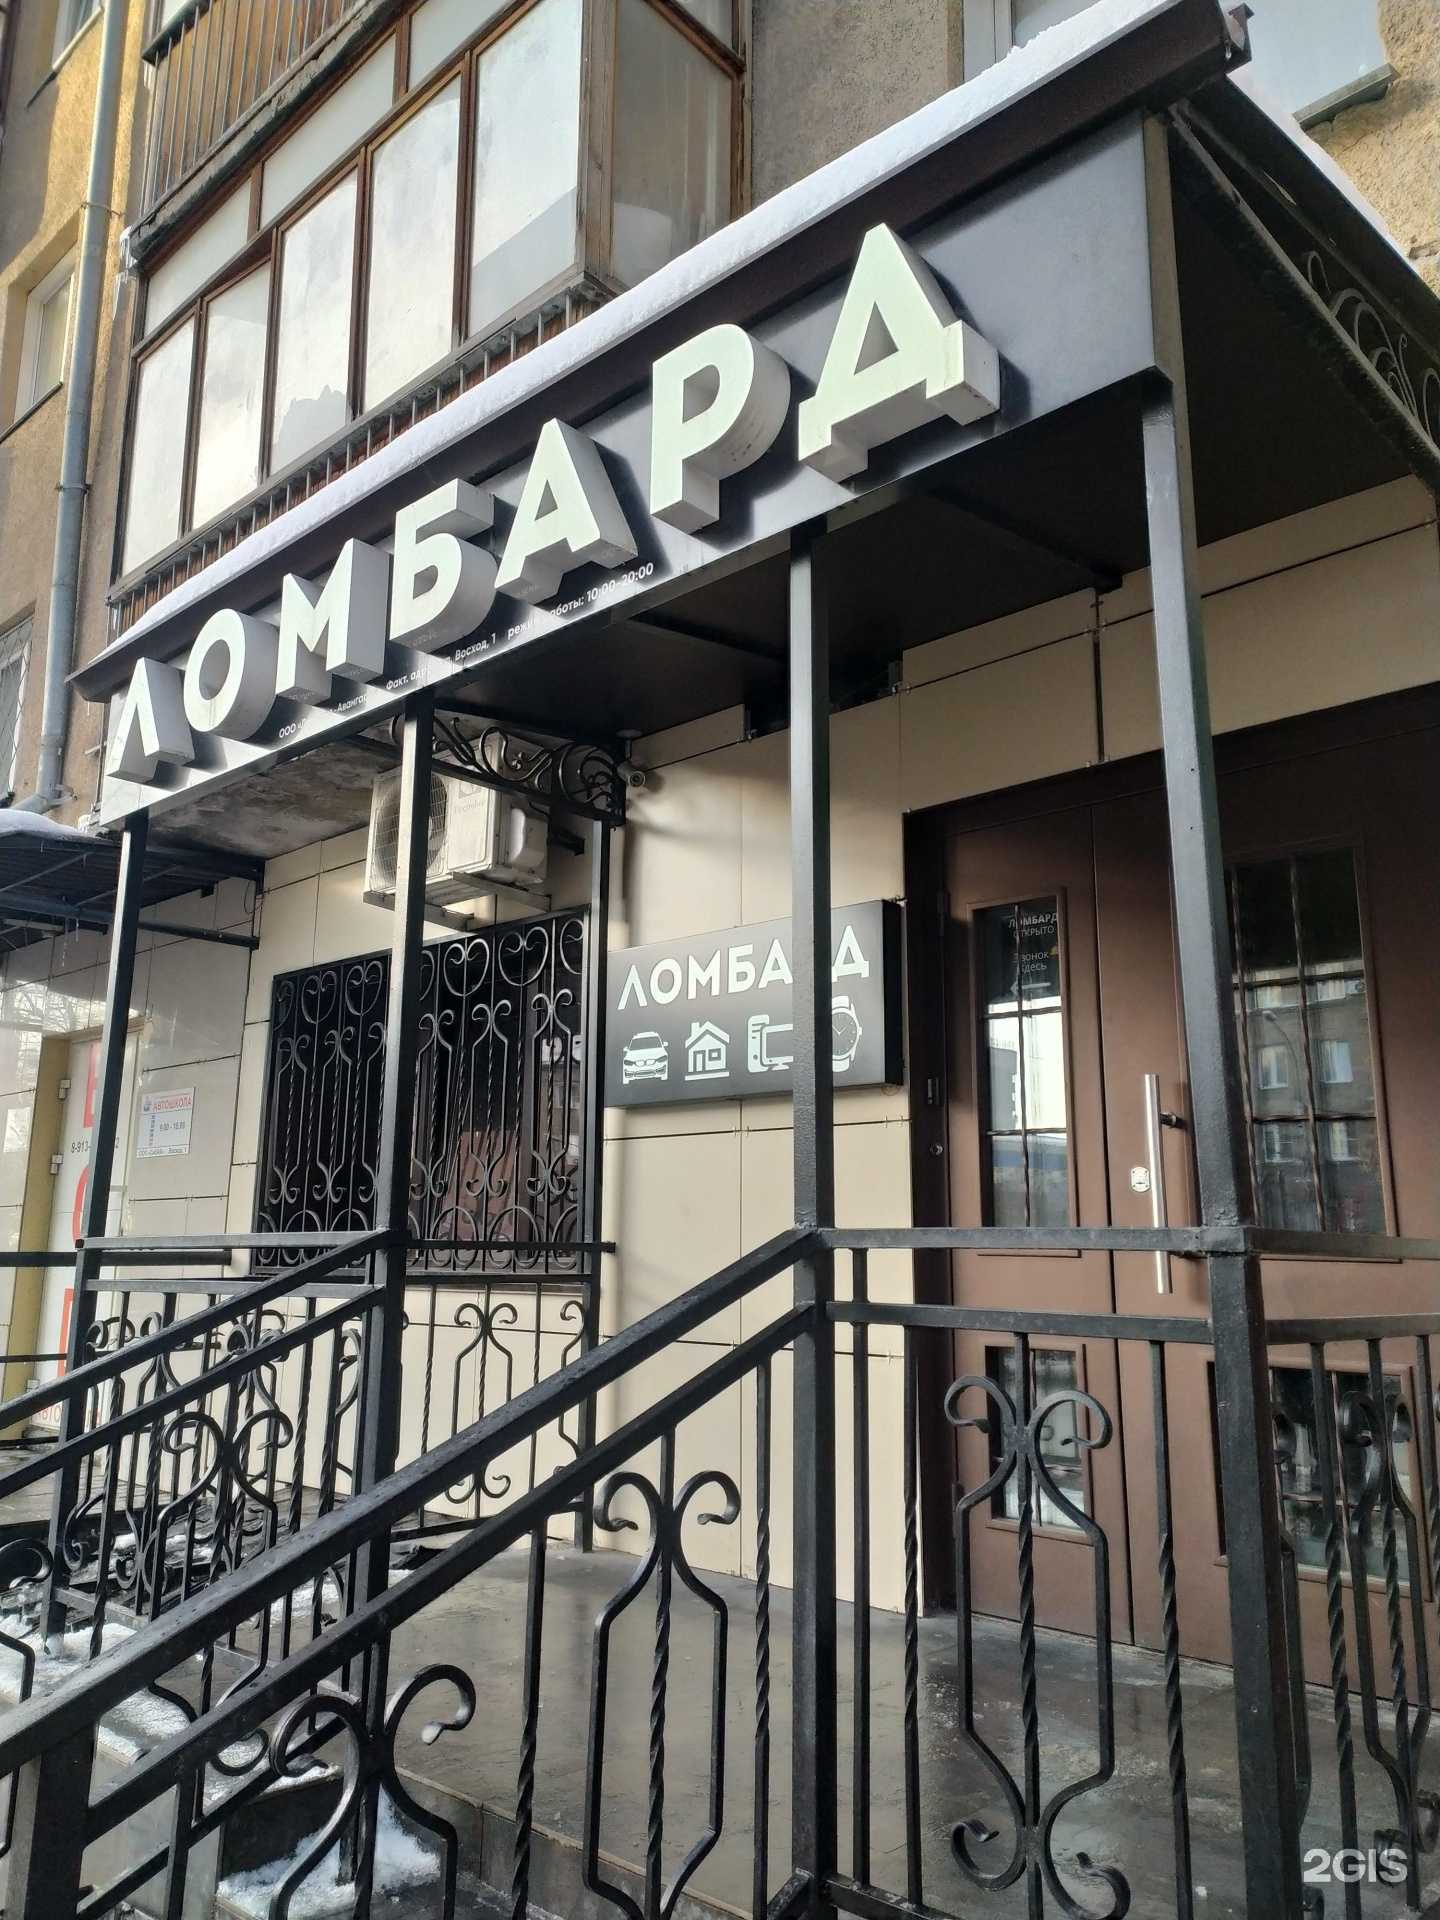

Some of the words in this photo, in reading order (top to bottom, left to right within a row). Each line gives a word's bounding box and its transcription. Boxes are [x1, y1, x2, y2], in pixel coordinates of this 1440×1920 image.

[106, 222, 972, 782] ЛОМБАРД
[279, 723, 296, 738] ООО
[386, 674, 409, 690] Факт.
[454, 639, 489, 661] Восход,
[491, 632, 497, 645] 1
[550, 595, 585, 617] аботы:
[586, 562, 654, 603] 10:00-20:00
[617, 924, 870, 1011] ЛОМБАД
[1008, 911, 1058, 929] ЛМБАРД
